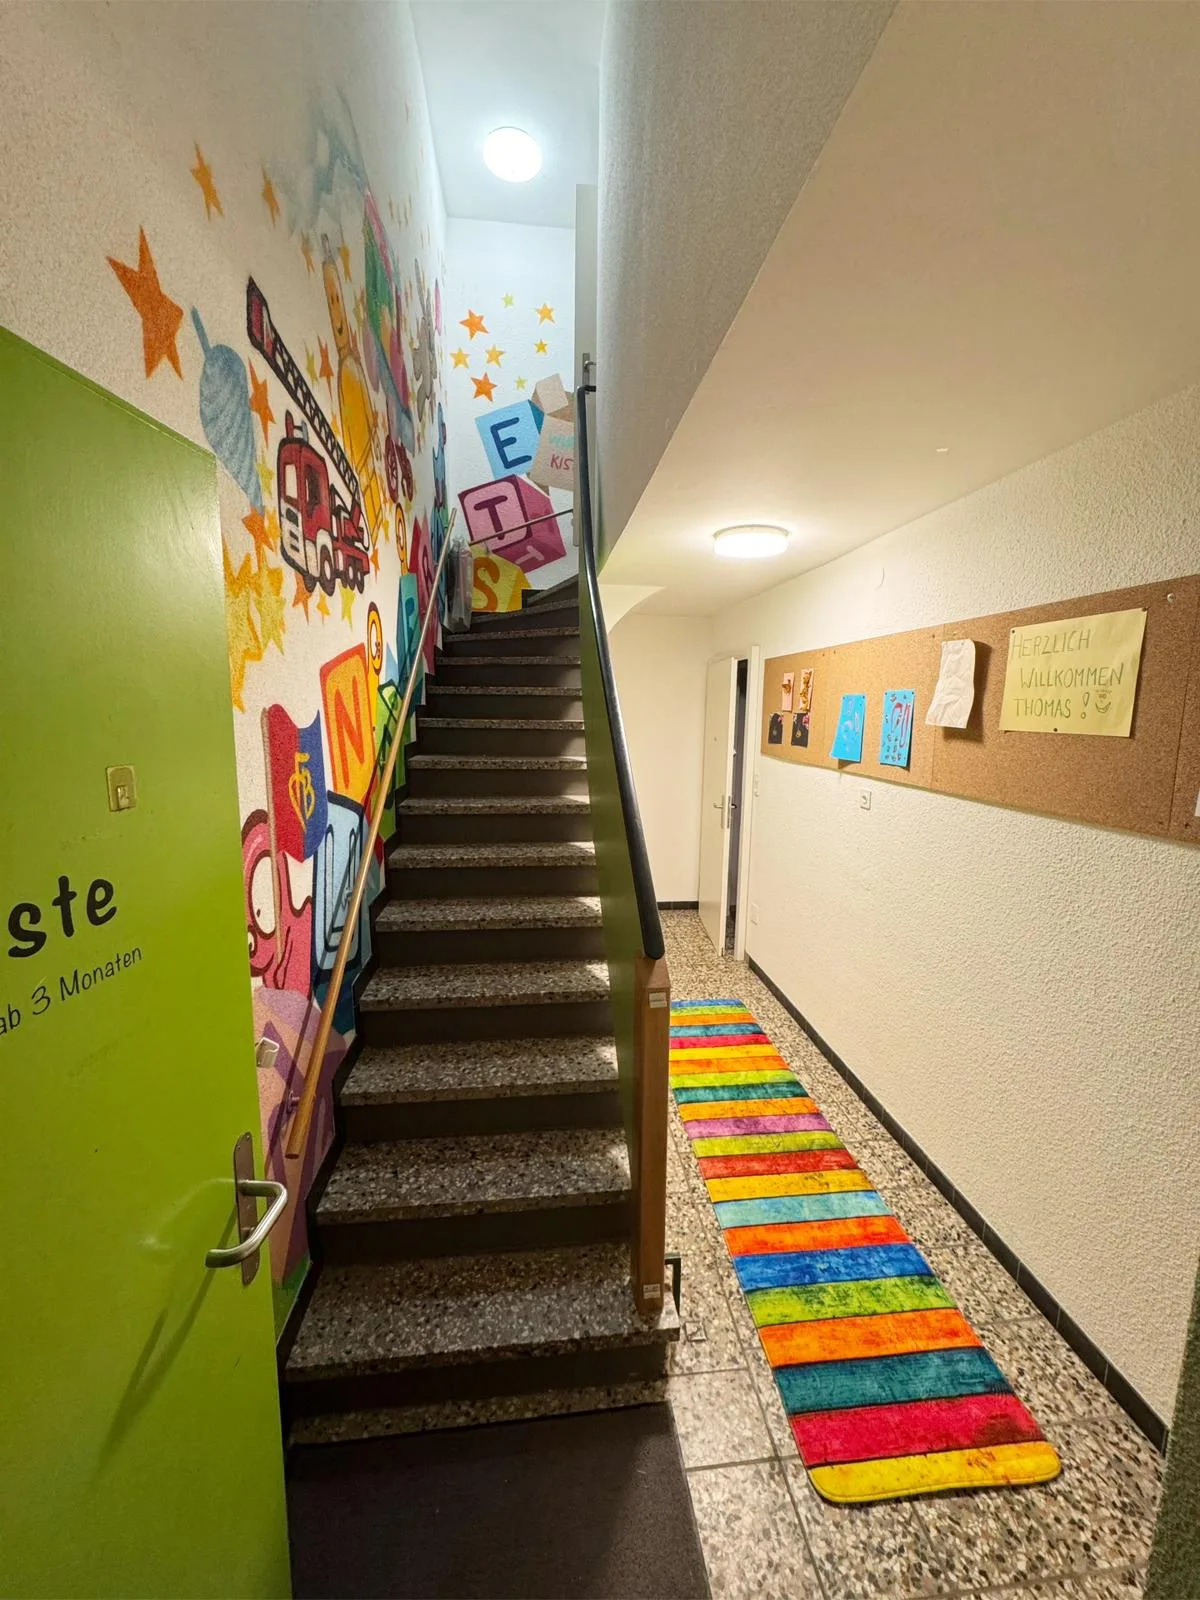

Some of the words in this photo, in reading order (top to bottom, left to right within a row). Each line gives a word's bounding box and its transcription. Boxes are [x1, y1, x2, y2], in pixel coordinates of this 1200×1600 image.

[490, 416, 532, 469] E
[473, 495, 508, 540] T
[1012, 629, 1092, 659] HERZLICH
[1020, 663, 1124, 689] WILLKOMMEN
[8, 875, 117, 958] ste
[31, 985, 51, 1015] 3
[59, 947, 143, 1001] Monaten
